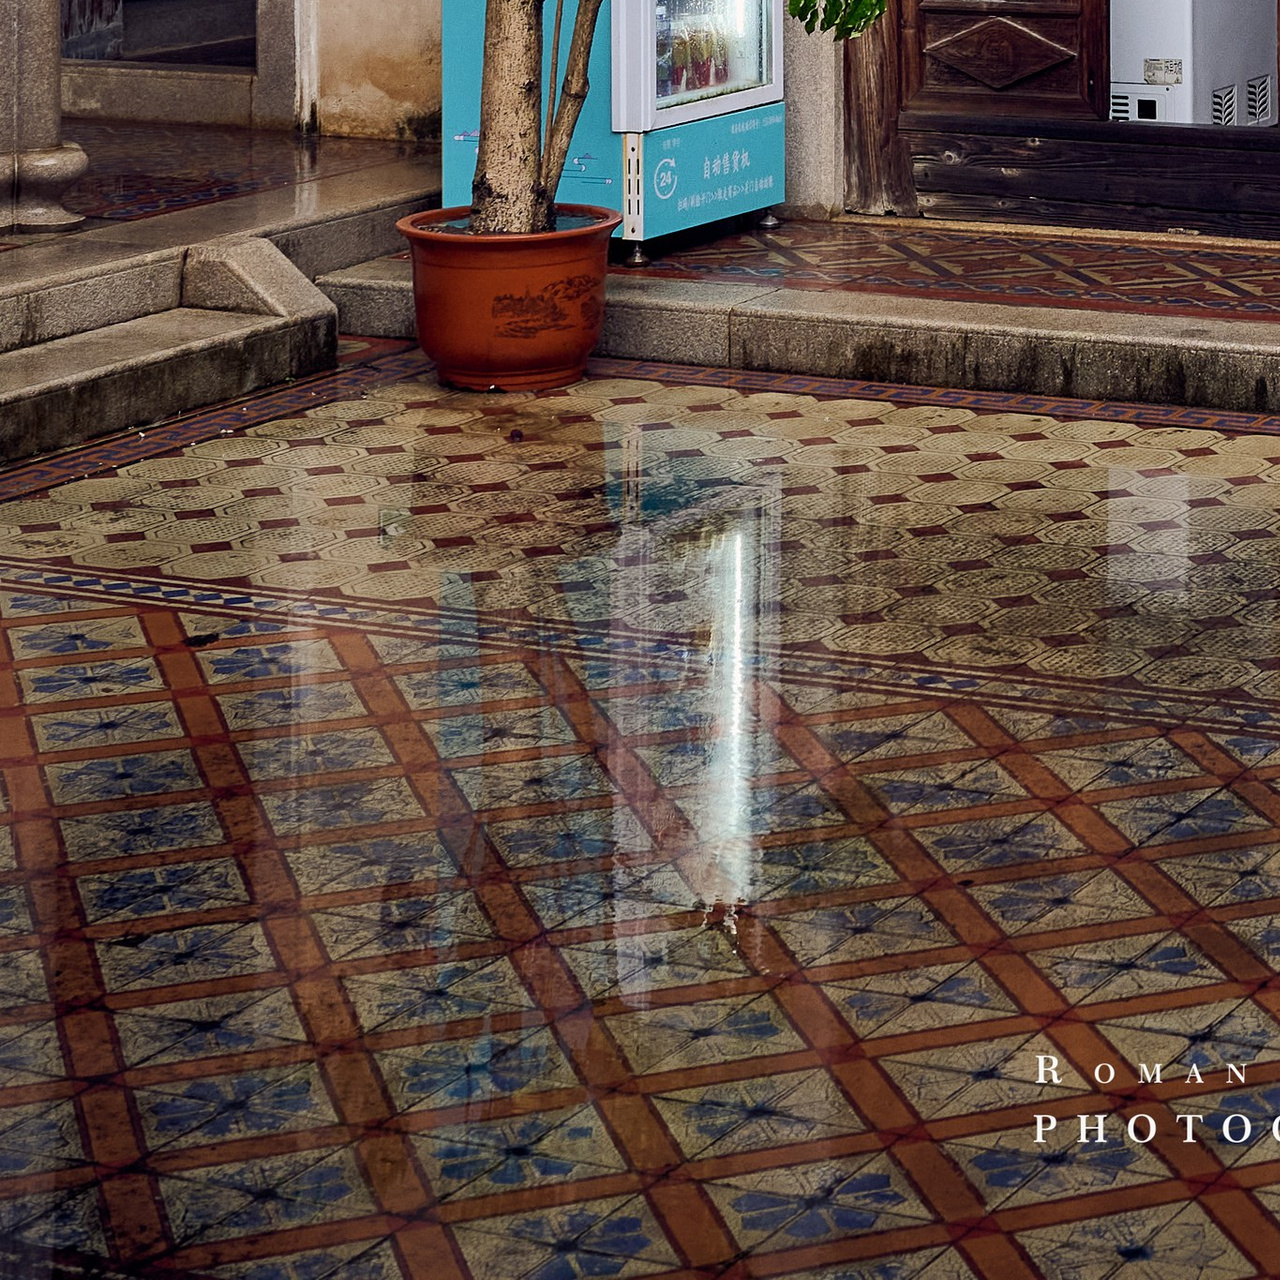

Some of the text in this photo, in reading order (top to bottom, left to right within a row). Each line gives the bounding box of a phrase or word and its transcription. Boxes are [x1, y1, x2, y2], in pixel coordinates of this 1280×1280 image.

[703, 148, 750, 180] 自动售货机
[660, 171, 671, 187] 24
